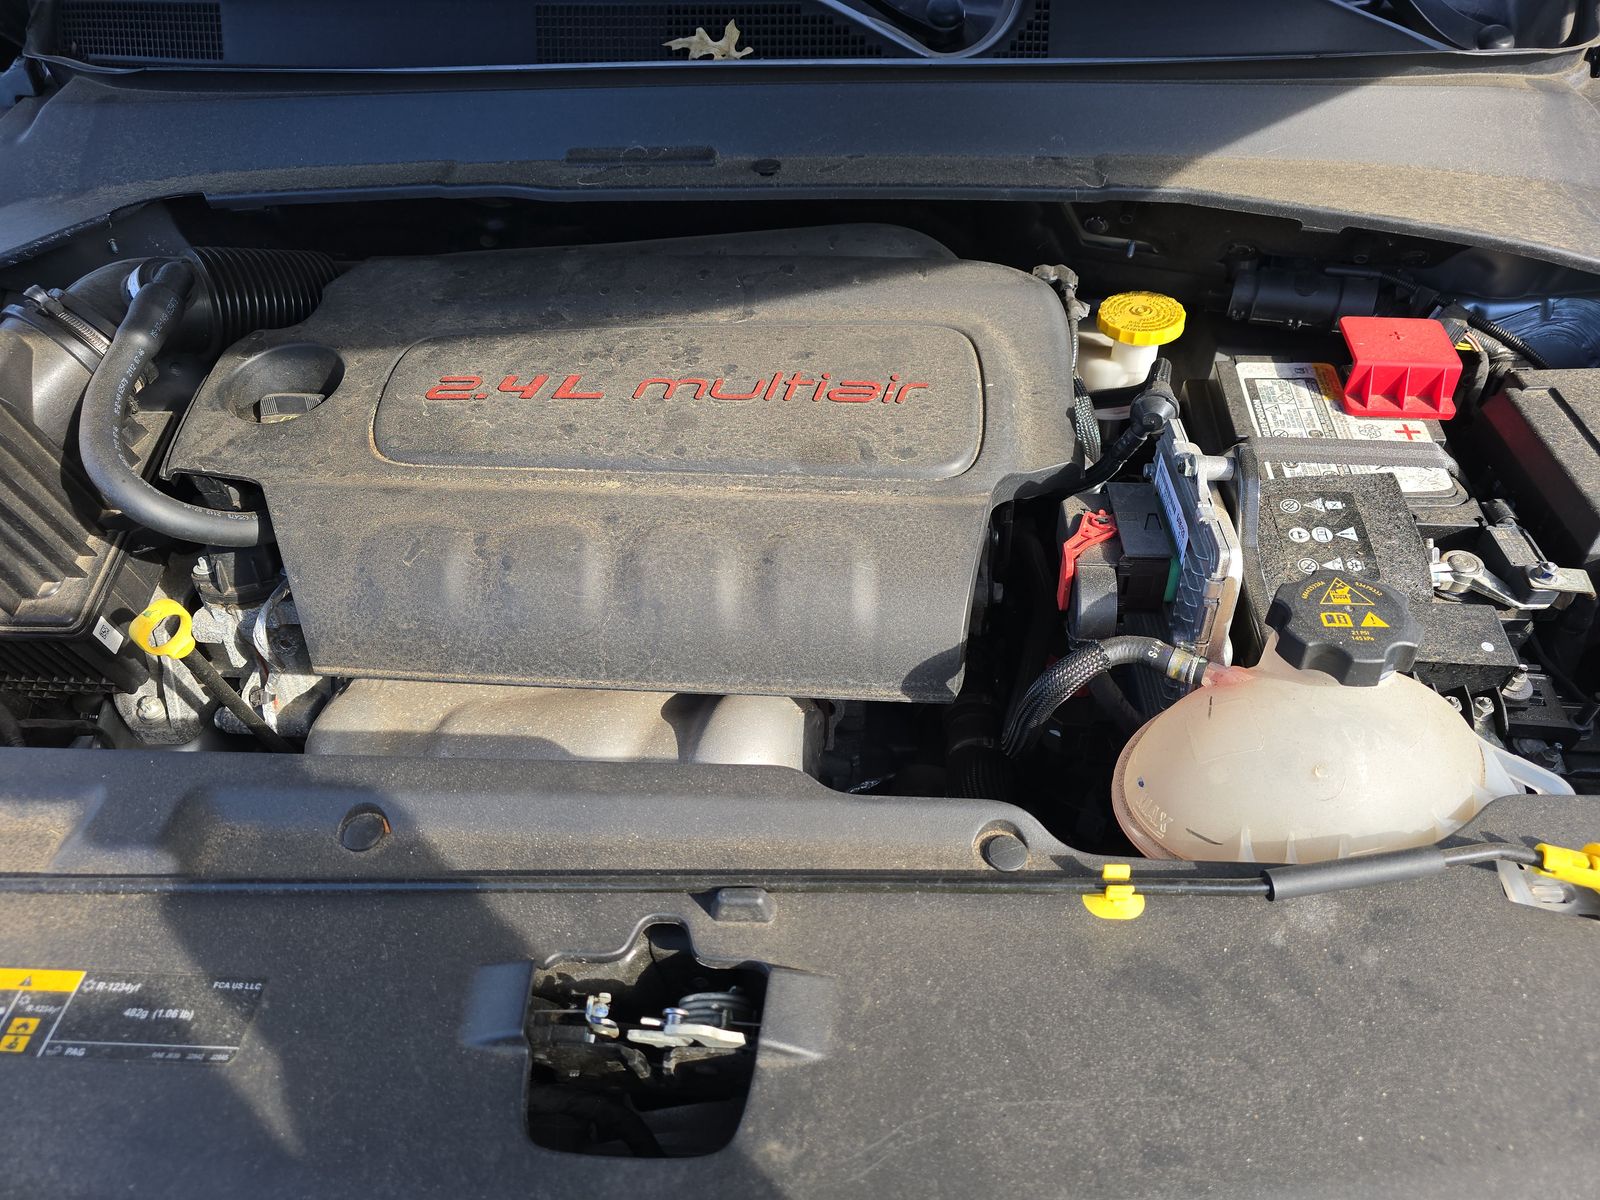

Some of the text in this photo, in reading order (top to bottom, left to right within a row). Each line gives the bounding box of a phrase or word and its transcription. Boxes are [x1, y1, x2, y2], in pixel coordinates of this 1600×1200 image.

[425, 371, 929, 404] 2.4L multiair
[96, 981, 262, 993] R-1234yf FCA US LLC
